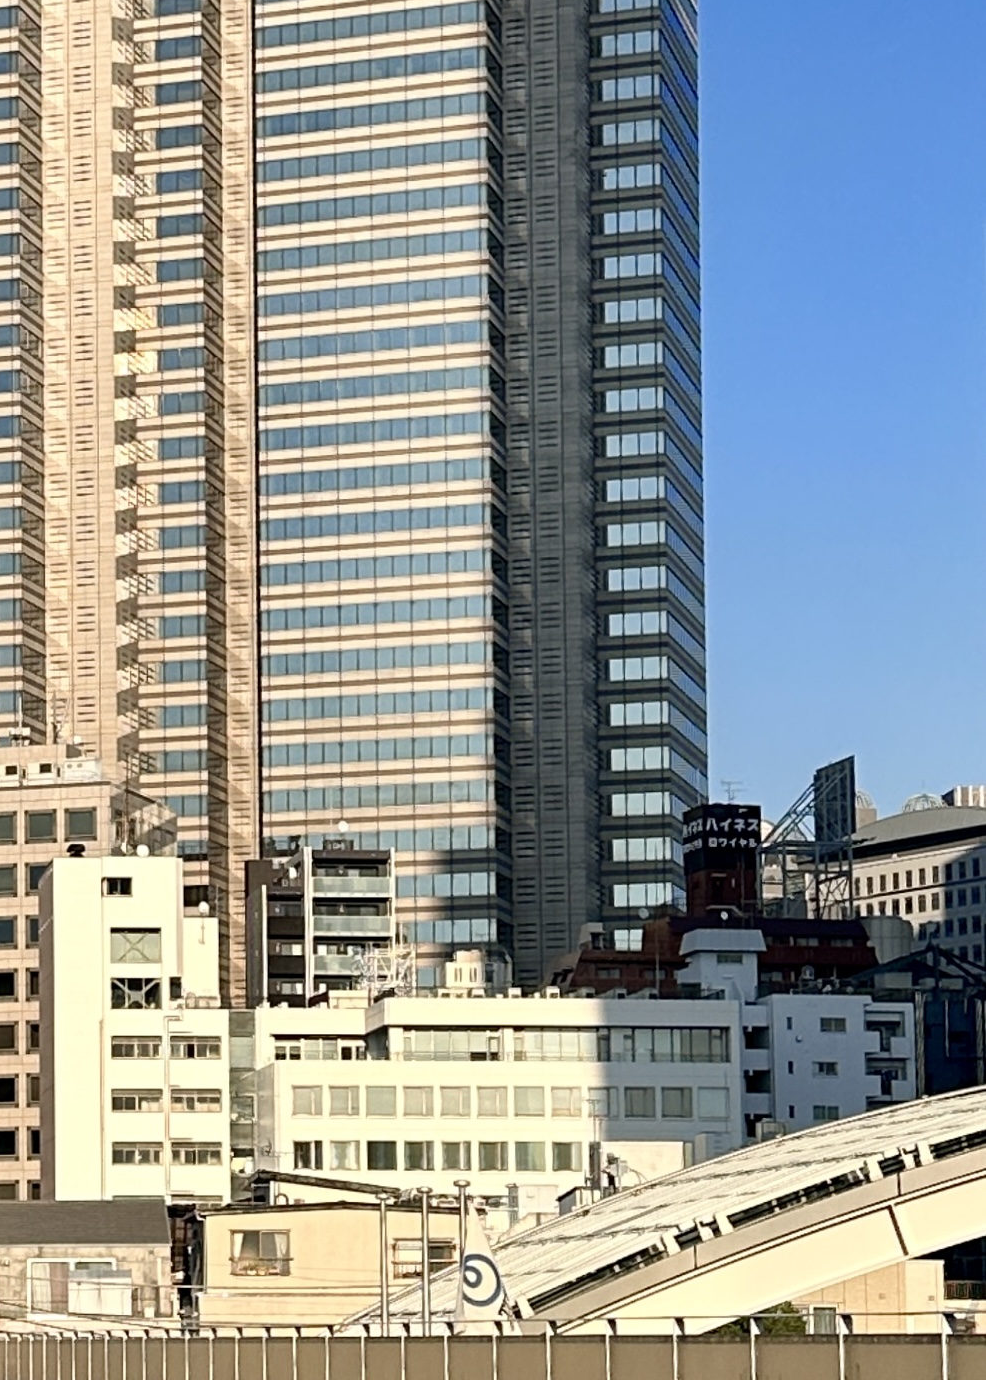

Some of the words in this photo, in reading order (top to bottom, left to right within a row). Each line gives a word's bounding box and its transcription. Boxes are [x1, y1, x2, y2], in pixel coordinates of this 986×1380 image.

[705, 817, 759, 832] ハイネス
[708, 837, 757, 848] ロワイヤル
